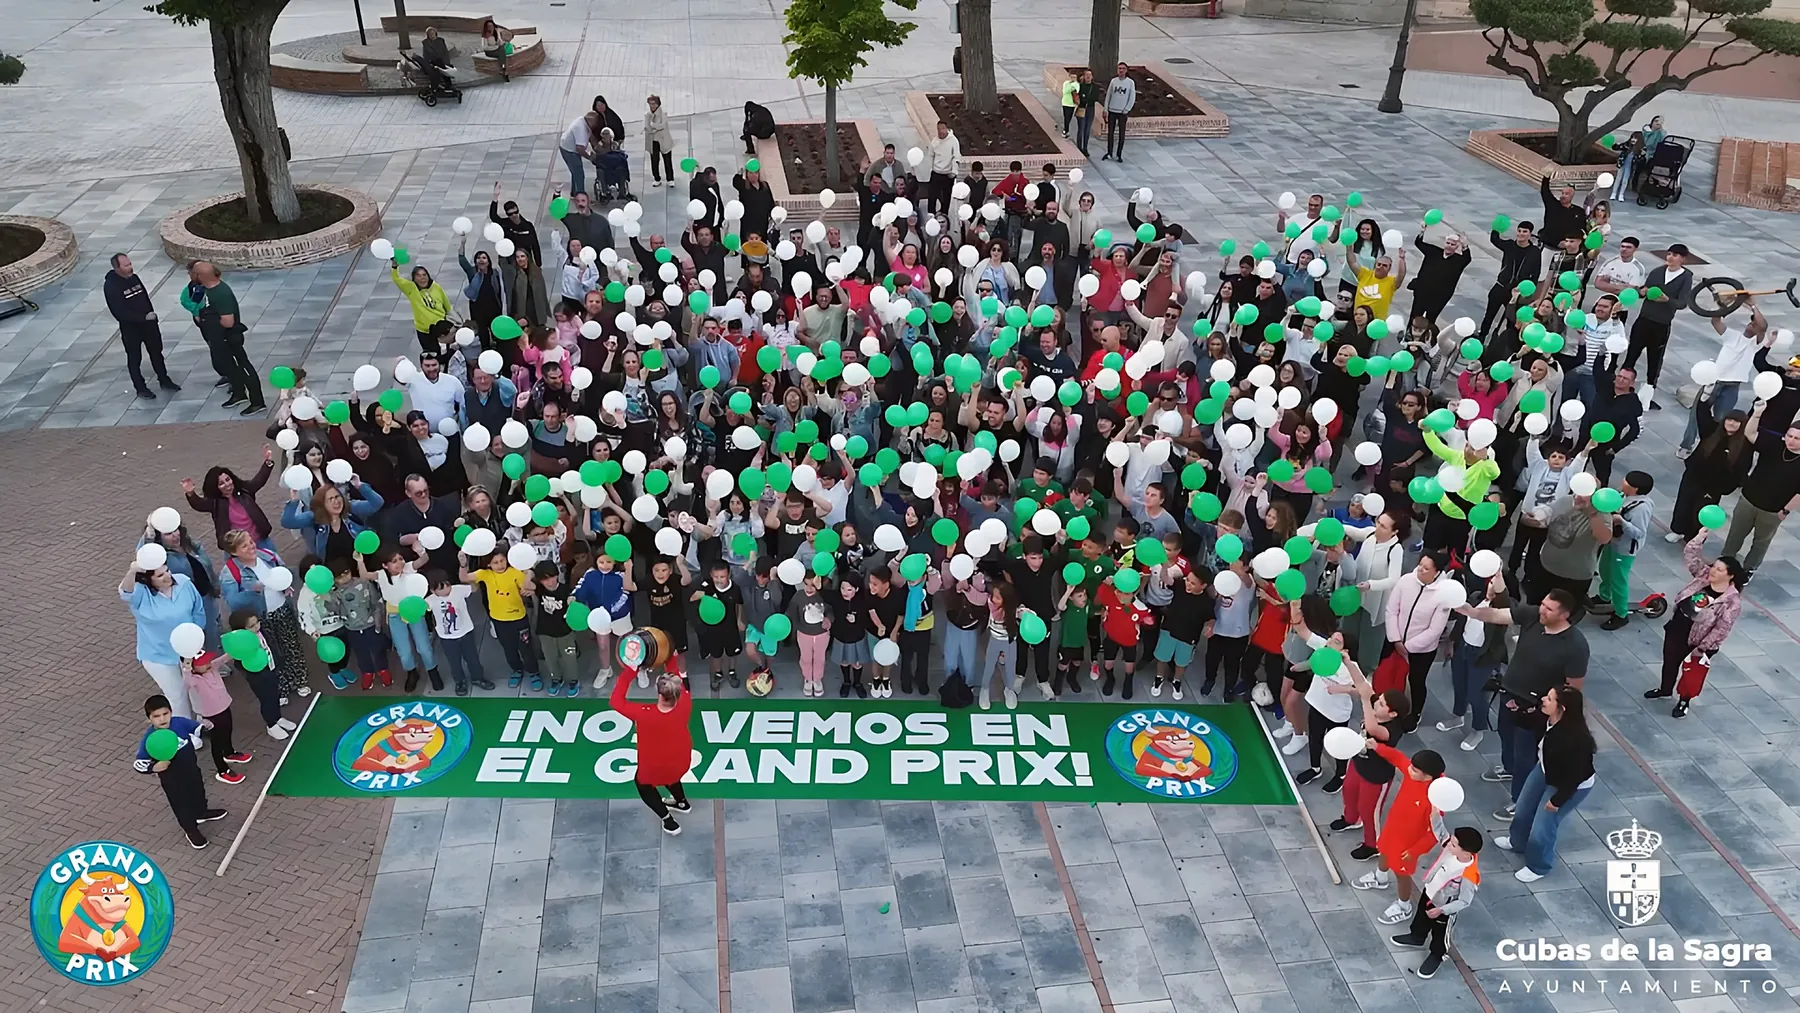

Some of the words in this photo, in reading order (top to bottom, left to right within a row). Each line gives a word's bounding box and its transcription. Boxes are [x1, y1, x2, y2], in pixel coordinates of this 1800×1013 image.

[366, 702, 462, 728] GRAND
[1117, 711, 1211, 735] GRAND
[499, 710, 638, 744] ¡NO
[701, 711, 950, 747] VEMOS
[970, 713, 1071, 747] EN
[351, 770, 422, 789] PRIX
[475, 748, 571, 783] EL
[890, 750, 1094, 787] PRIX!
[1145, 776, 1215, 796] PRIX
